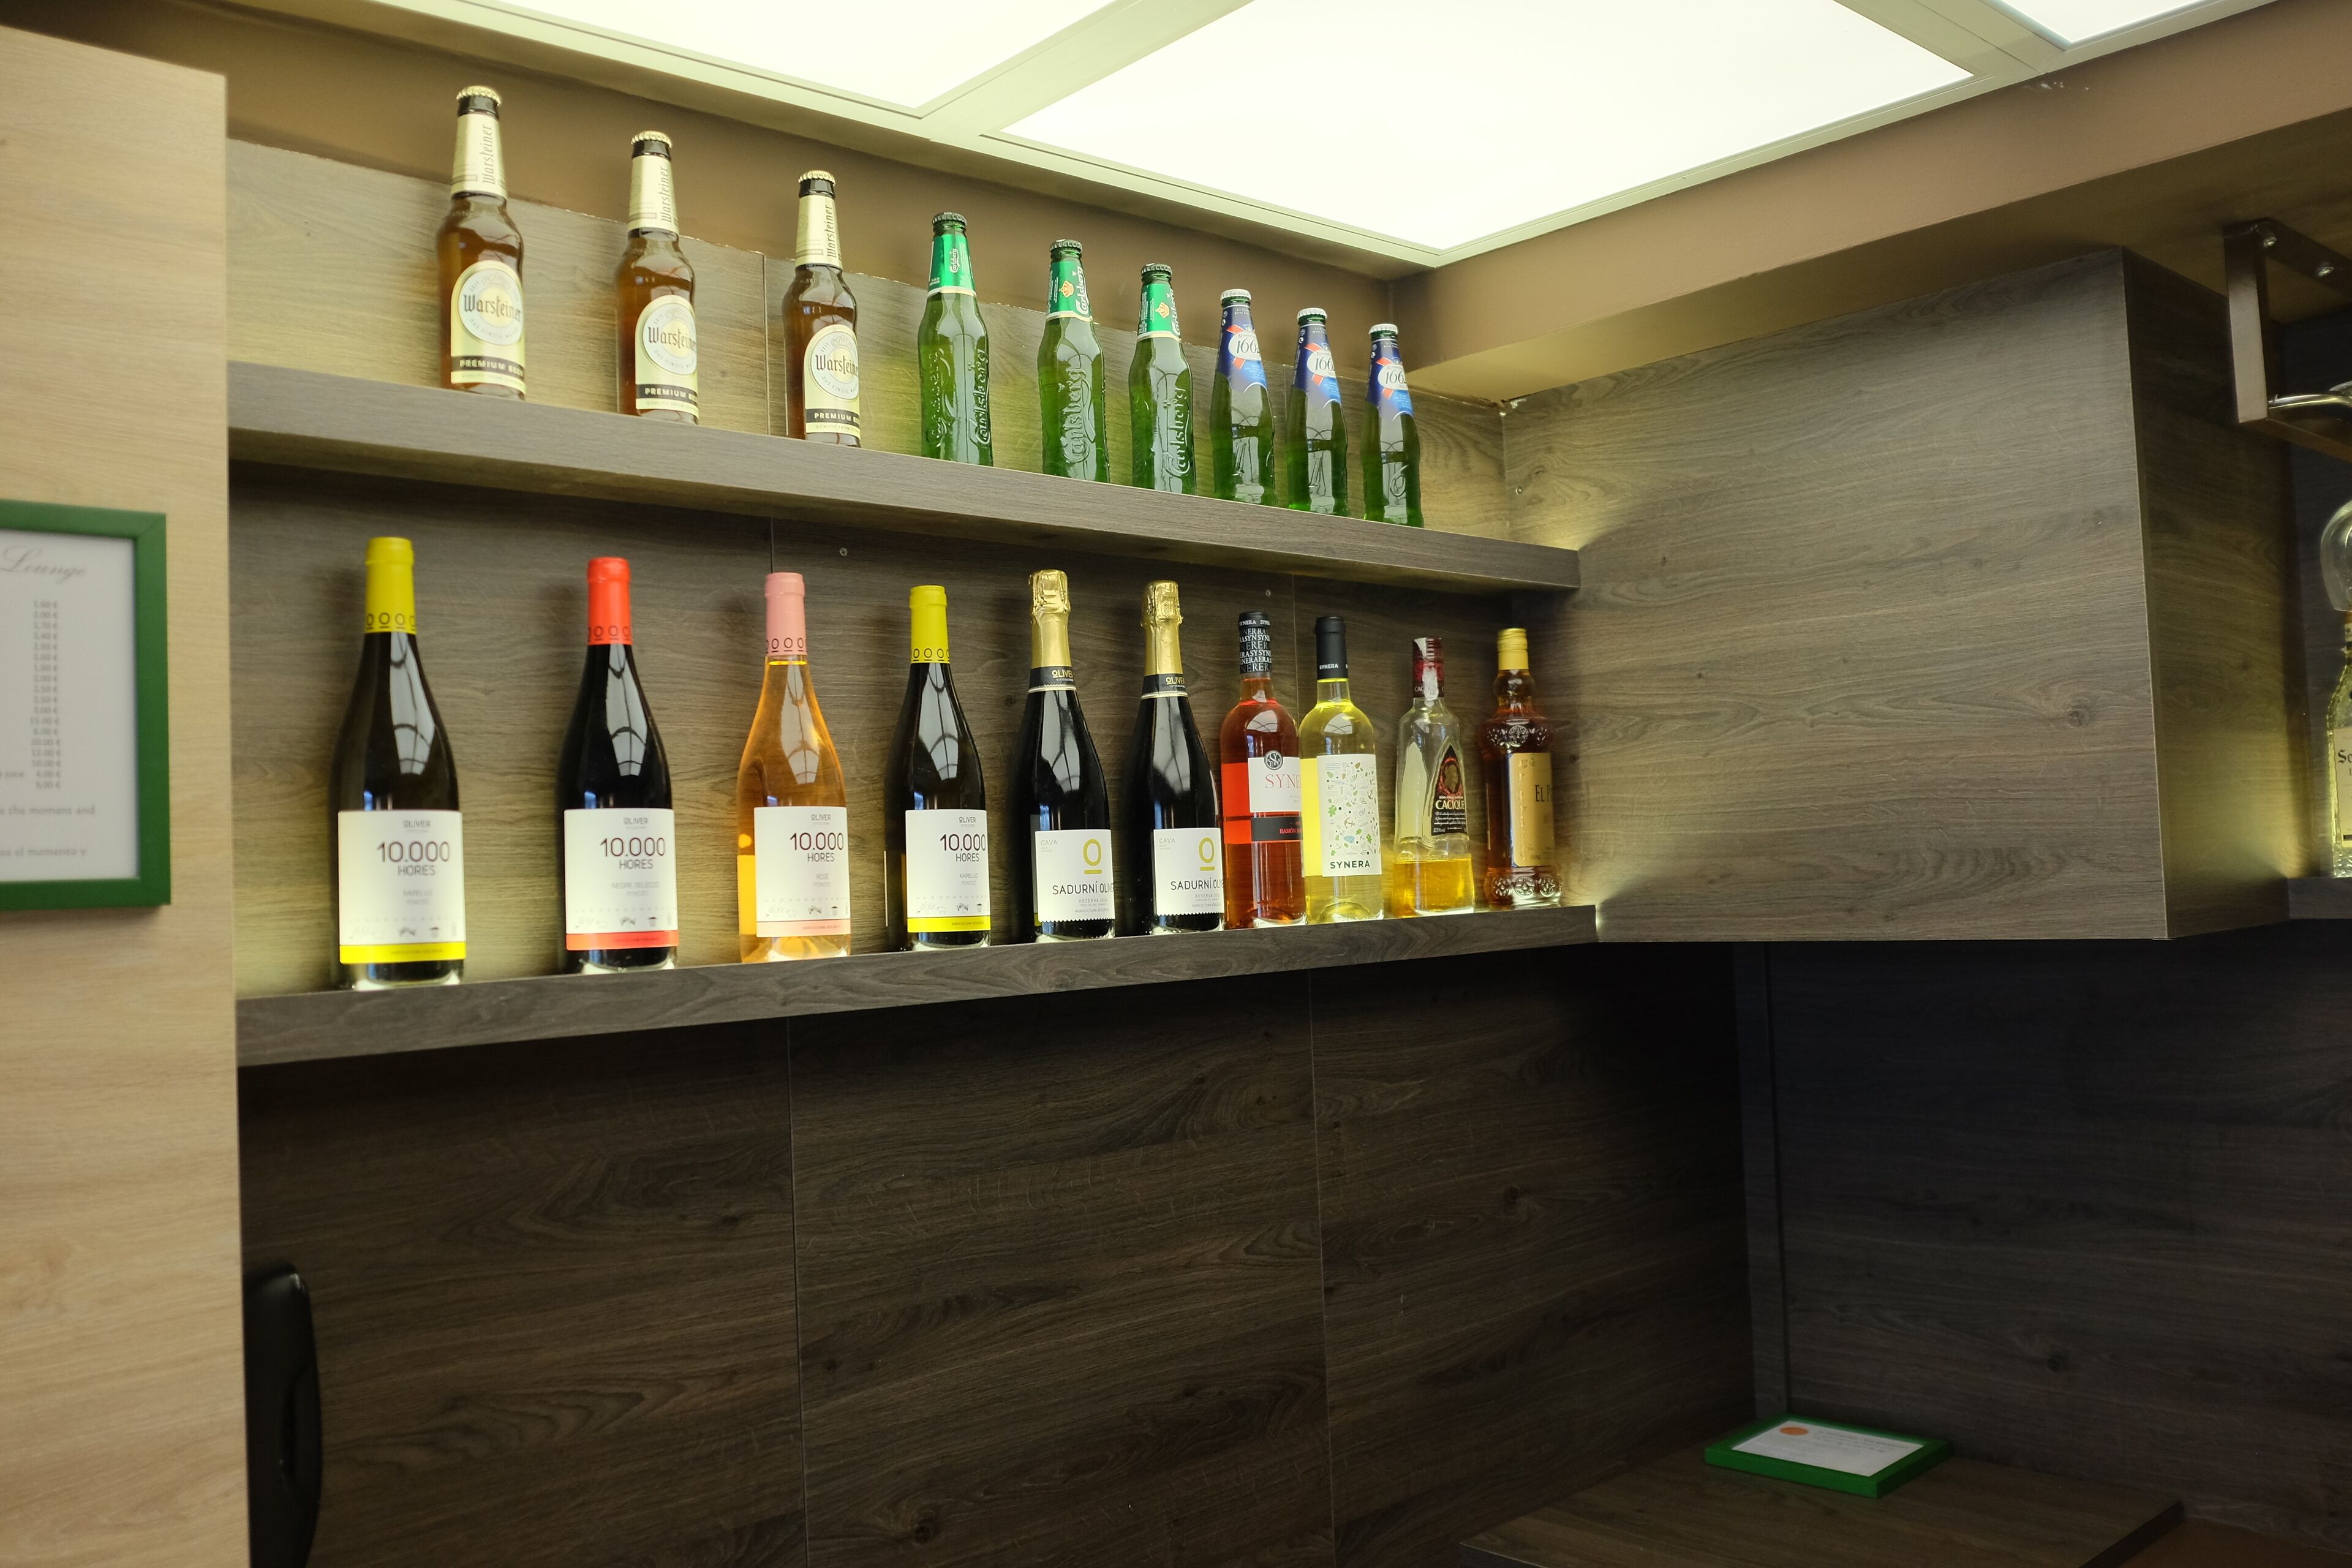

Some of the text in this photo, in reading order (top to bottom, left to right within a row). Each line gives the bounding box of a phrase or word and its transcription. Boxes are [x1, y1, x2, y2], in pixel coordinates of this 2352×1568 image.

[480, 124, 496, 184] Warsteiner
[658, 166, 672, 222] Warsteiner
[824, 205, 837, 258] Warsteiner
[1076, 266, 1089, 314] Carlsberg
[463, 294, 521, 322] Warsteiner
[1236, 337, 1260, 354] 166
[459, 360, 505, 371] PREMIUM
[1315, 356, 1335, 371] 166
[1385, 369, 1406, 384] 166
[644, 387, 687, 398] PREMIUM
[814, 412, 851, 421] PREMIUM
[0, 545, 86, 584] Lounge
[76, 805, 95, 815] and
[1435, 800, 1465, 810] CACIQUE
[600, 837, 666, 857] 10.000
[790, 832, 844, 851] 10.000
[940, 834, 986, 851] 10.000
[377, 841, 450, 862] 10.000
[807, 852, 835, 862] HORES
[956, 853, 980, 862] HORES
[397, 864, 435, 876] HORES
[619, 859, 654, 869] HORES
[1330, 860, 1370, 869] SYNERA
[1052, 881, 1098, 895] SADURNÍ
[1170, 877, 1212, 891] SADURNÍ
